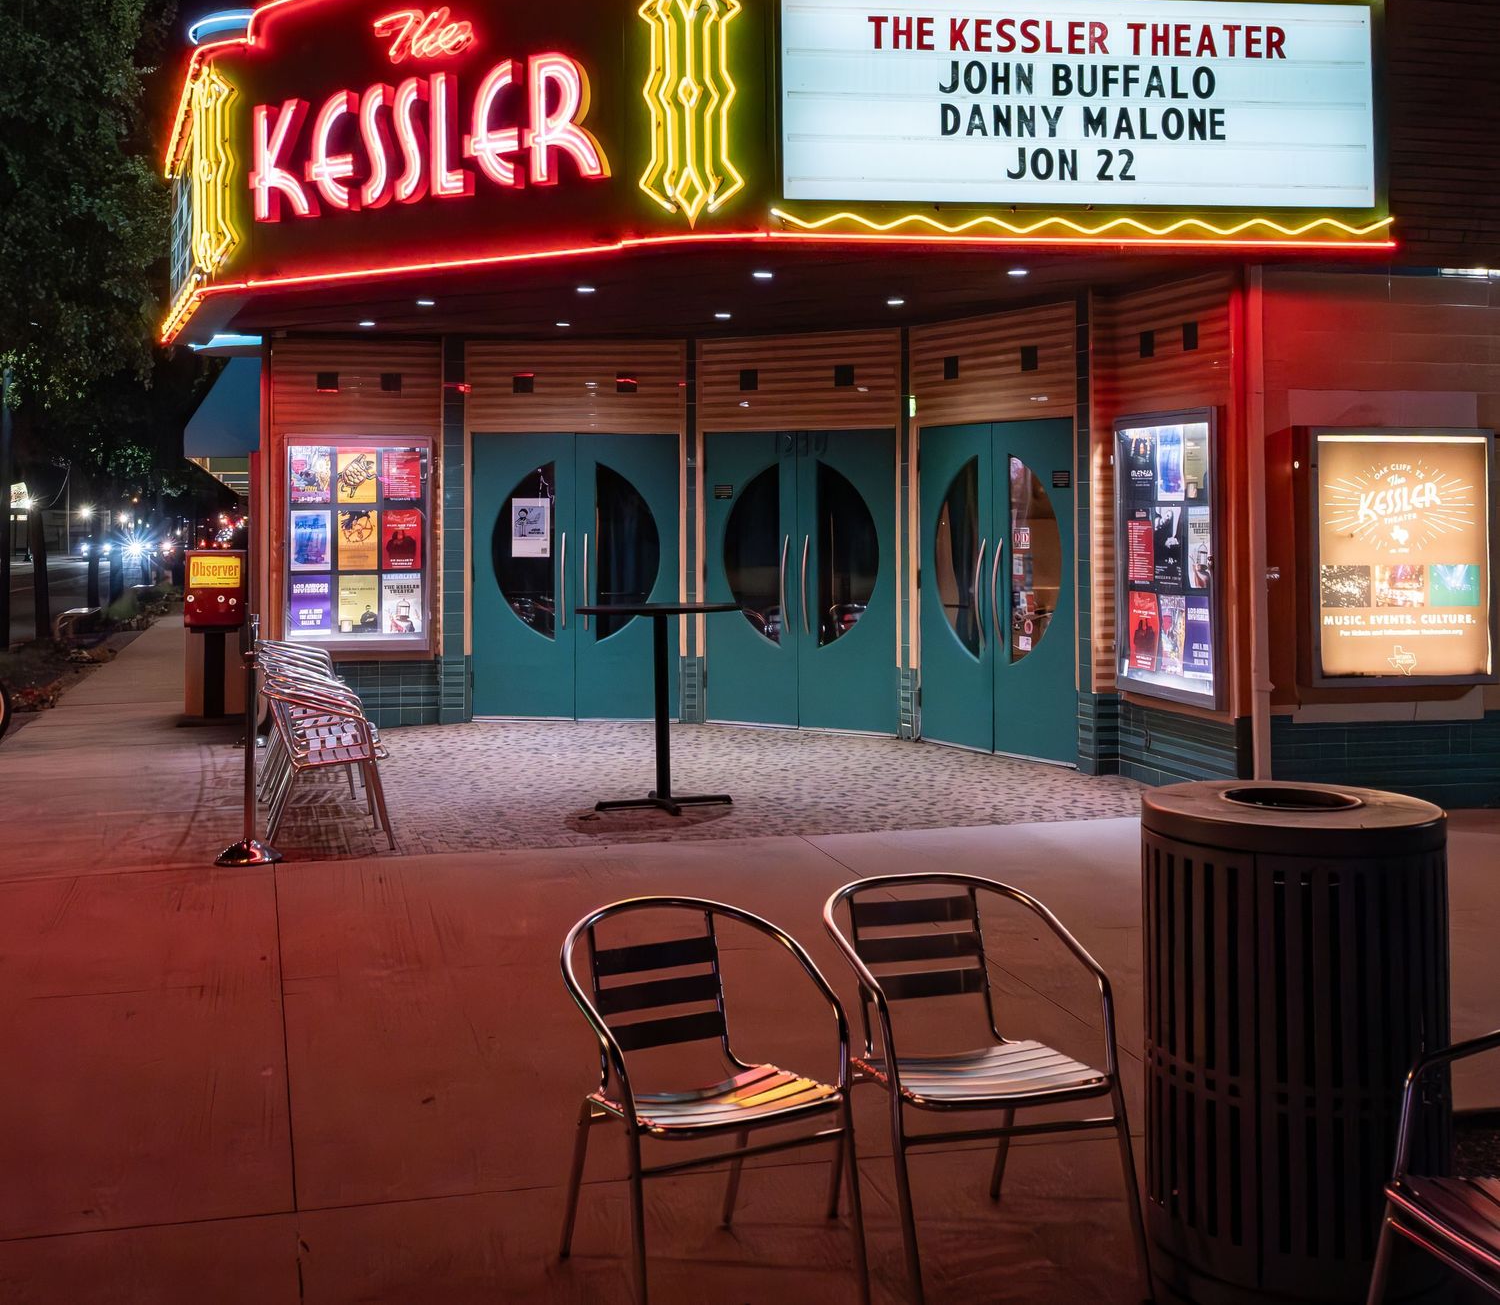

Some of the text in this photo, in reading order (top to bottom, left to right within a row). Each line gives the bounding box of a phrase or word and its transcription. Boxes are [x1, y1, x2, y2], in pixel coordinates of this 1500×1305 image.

[373, 6, 475, 64] The
[868, 16, 1287, 59] THE KESSLER THEATER
[939, 61, 1216, 100] JOHN BUFFALO
[249, 51, 611, 223] KESSLER
[941, 104, 1226, 141] DANNY MALONE
[1006, 147, 1136, 182] JON 22
[1374, 466, 1389, 480] OAK
[1415, 470, 1425, 479] TX
[1387, 474, 1406, 486] The
[1358, 482, 1441, 523] KESSLER
[1384, 513, 1417, 524] THEATER
[192, 561, 239, 577] Observer
[1324, 614, 1476, 625] MUSIC. EVENTS. CULTURE.
